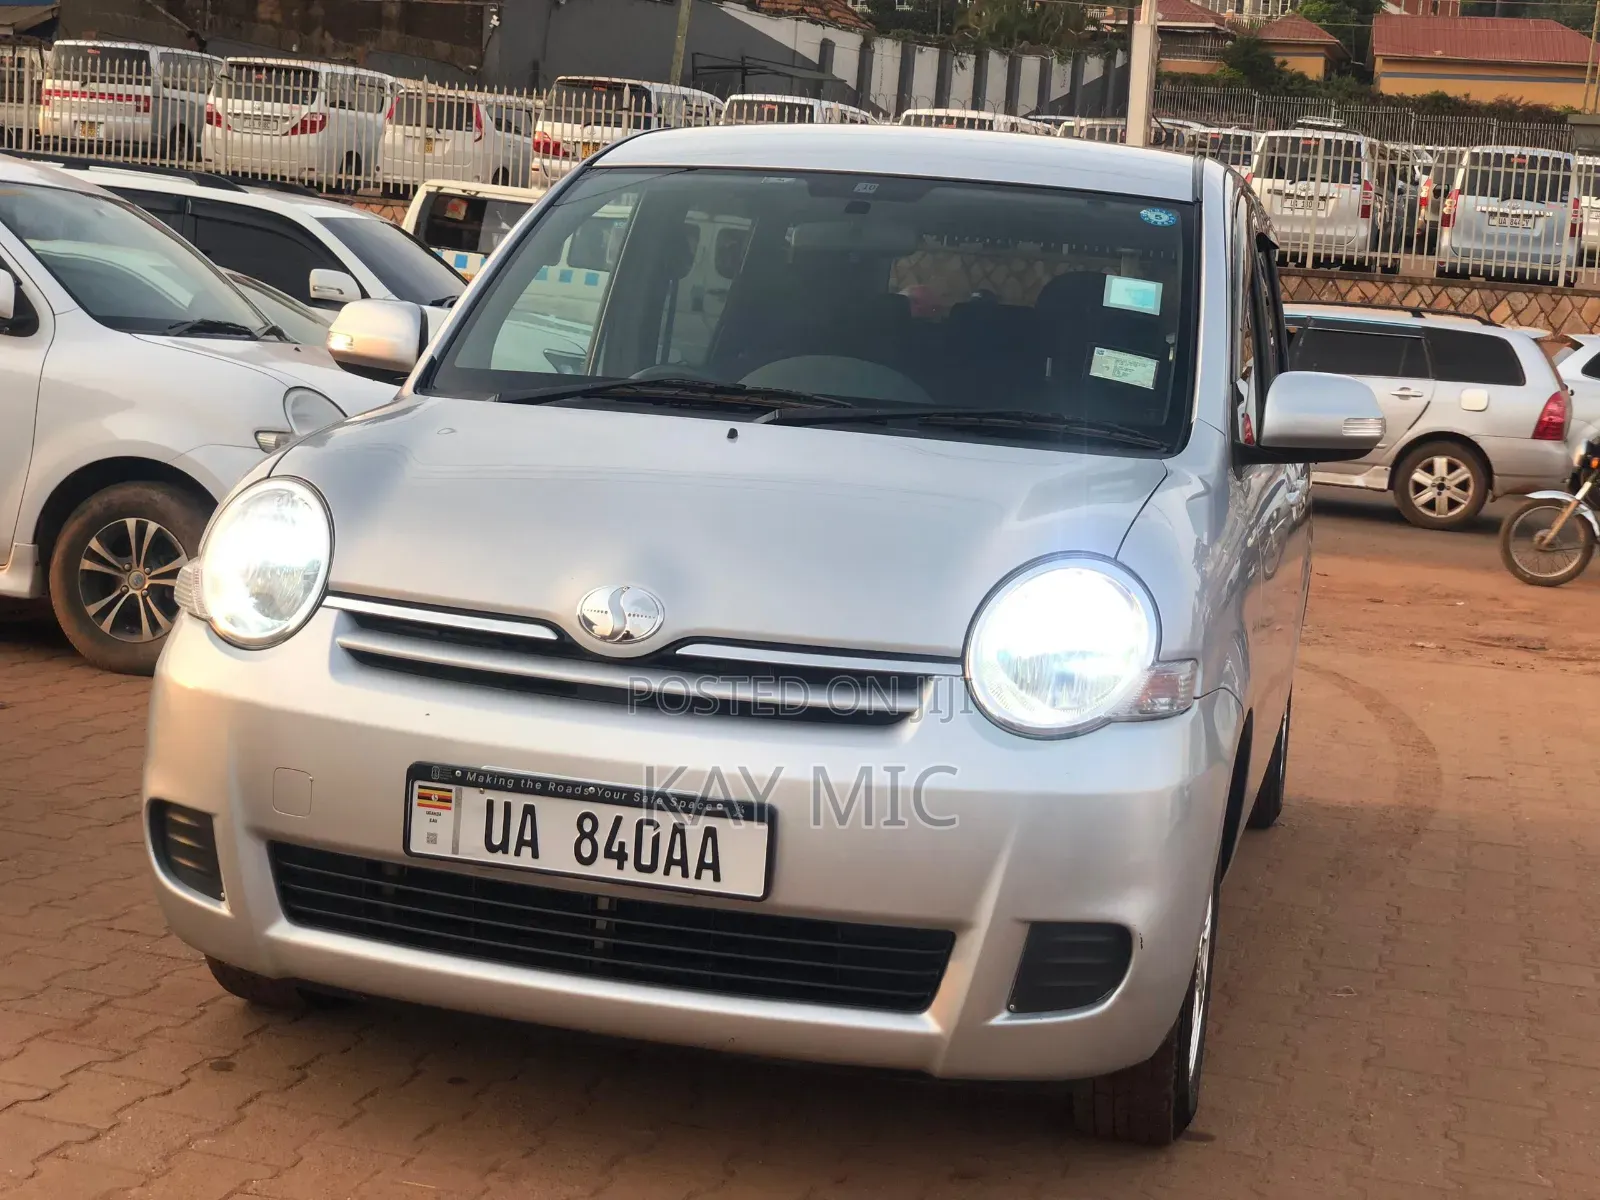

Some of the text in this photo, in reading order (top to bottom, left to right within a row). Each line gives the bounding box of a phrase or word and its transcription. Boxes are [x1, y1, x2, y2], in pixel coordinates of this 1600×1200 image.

[1498, 217, 1507, 225] UA
[466, 771, 514, 789] Making
[520, 779, 542, 791] the
[548, 781, 590, 796] Roads
[596, 786, 627, 801] Your
[633, 791, 663, 806] Safe
[669, 796, 713, 812] Space
[484, 798, 722, 883] UA 840AA
